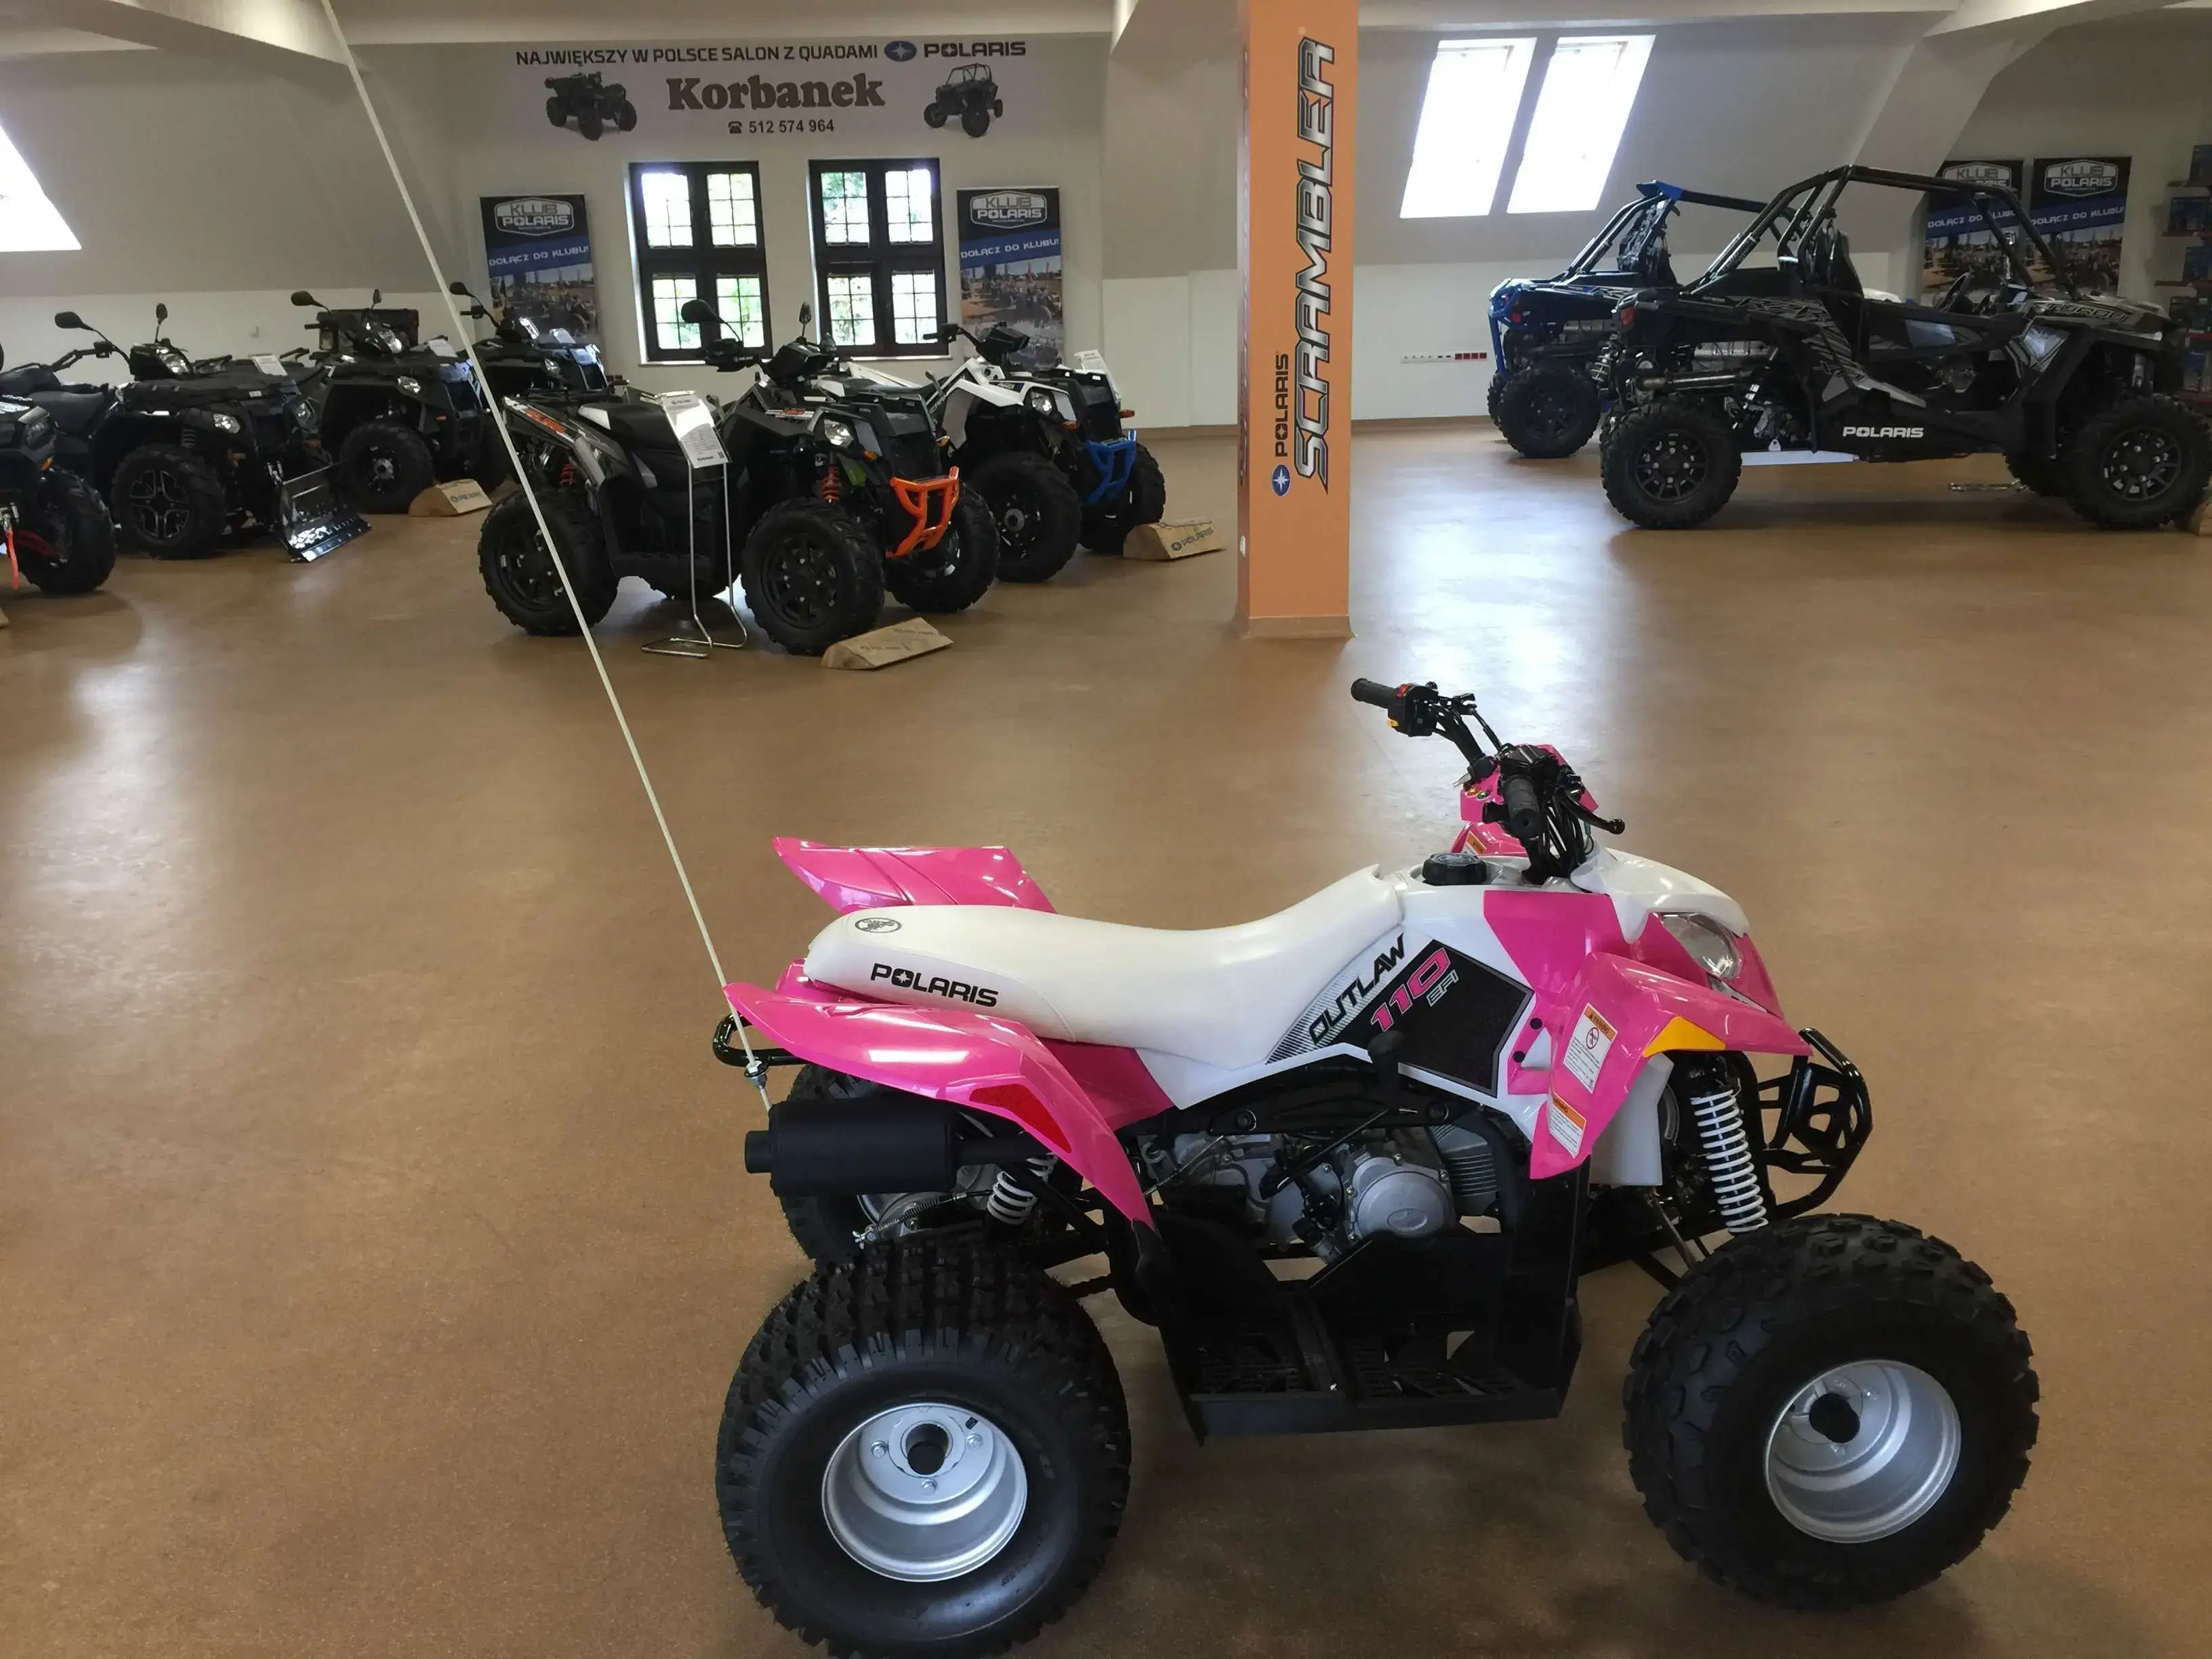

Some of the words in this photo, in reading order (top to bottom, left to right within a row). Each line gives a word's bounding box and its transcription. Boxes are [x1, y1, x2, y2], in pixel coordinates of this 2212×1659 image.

[516, 49, 627, 66] NAJWIĘKSZY
[633, 49, 649, 63] W
[653, 47, 718, 62] POLSCE
[722, 45, 779, 62] SALON
[784, 45, 795, 59] Z
[799, 44, 878, 62] QUADAMI
[924, 41, 1027, 58] POLARIS
[666, 73, 886, 110] Korbanek
[749, 121, 775, 134] 512
[779, 119, 804, 133] 574
[809, 119, 835, 132] 964
[1957, 168, 1999, 179] KLUB
[2051, 177, 2112, 187] POLARIS
[510, 203, 558, 216] KLUB
[985, 197, 1031, 209] KLUB
[977, 208, 1042, 220] POLARIS
[1969, 214, 1983, 222] DO
[2072, 211, 2087, 220] DO
[502, 215, 569, 227] POLARIS
[1005, 244, 1019, 252] DO
[533, 251, 548, 260] DO
[1294, 36, 1335, 495] SCRAMBLER
[1275, 353, 1289, 457] POLARIS
[1843, 426, 1924, 438] POLARIS
[1181, 527, 1214, 547] POLARIS
[870, 962, 999, 1008] POLARIS
[1309, 932, 1405, 1046] OUTLAW
[1370, 947, 1451, 1033] 110
[1426, 968, 1459, 1007] EFI
